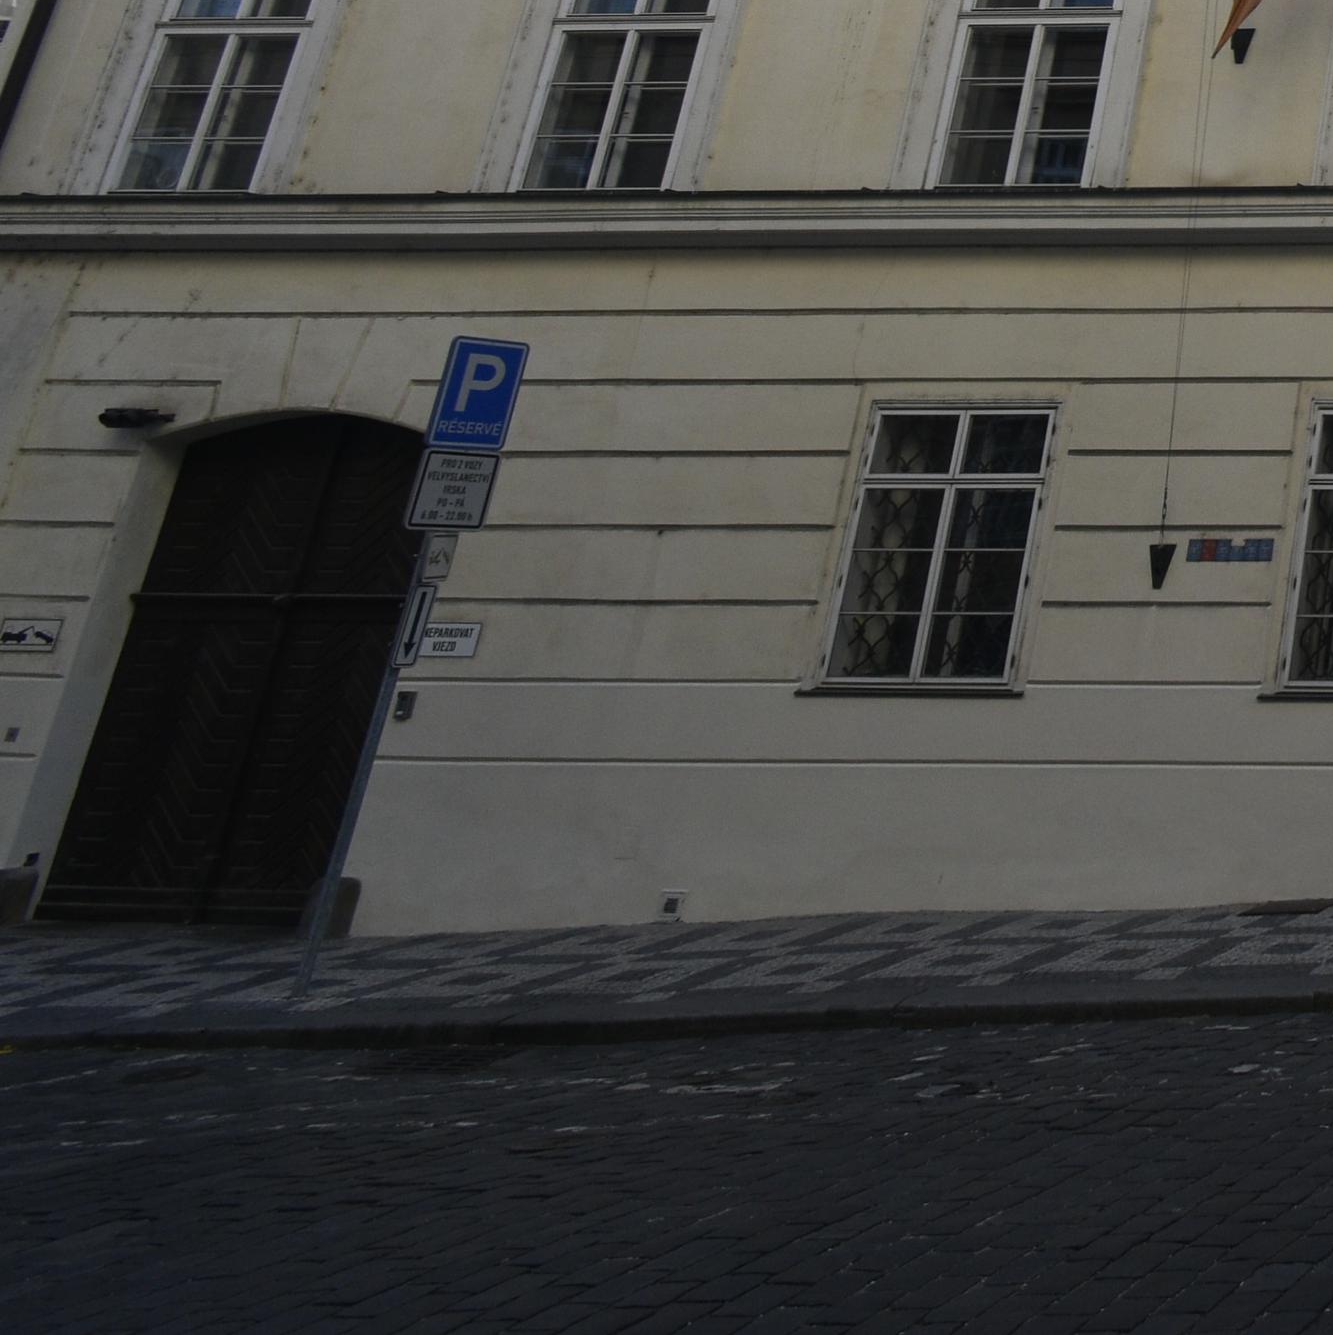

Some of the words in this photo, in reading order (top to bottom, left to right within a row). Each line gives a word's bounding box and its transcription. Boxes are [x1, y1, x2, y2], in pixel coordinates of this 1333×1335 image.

[454, 353, 506, 412] P
[437, 418, 502, 437] RÉSERVÉ
[440, 458, 457, 468] PRO
[464, 460, 483, 470] VOZY
[432, 641, 457, 651] VJEZD
